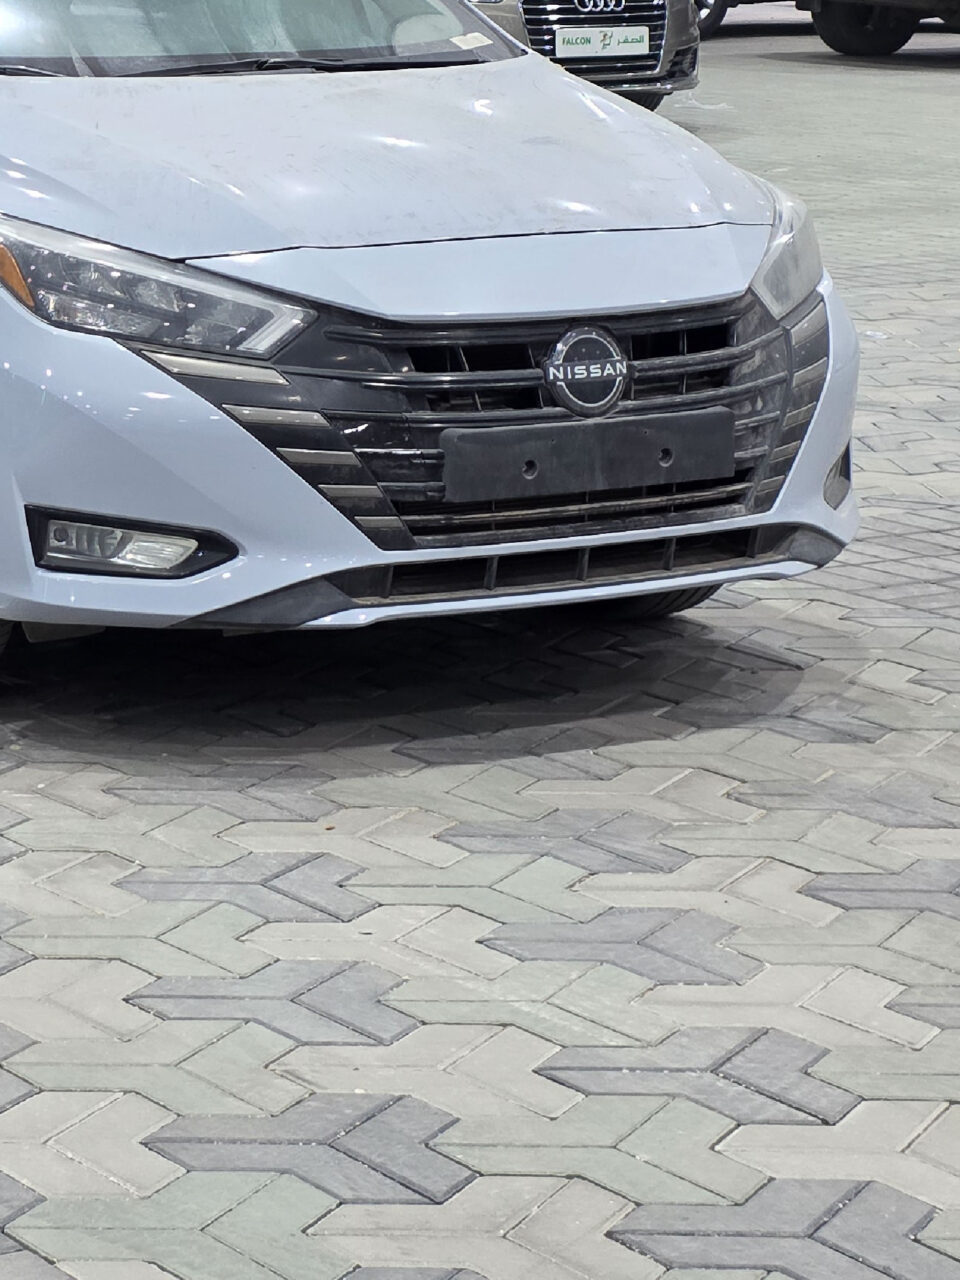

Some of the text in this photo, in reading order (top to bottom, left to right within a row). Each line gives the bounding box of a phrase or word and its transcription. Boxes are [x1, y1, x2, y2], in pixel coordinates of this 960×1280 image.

[562, 36, 591, 46] FALCON
[616, 34, 645, 46] الصقر
[548, 361, 627, 380] NISSAN
